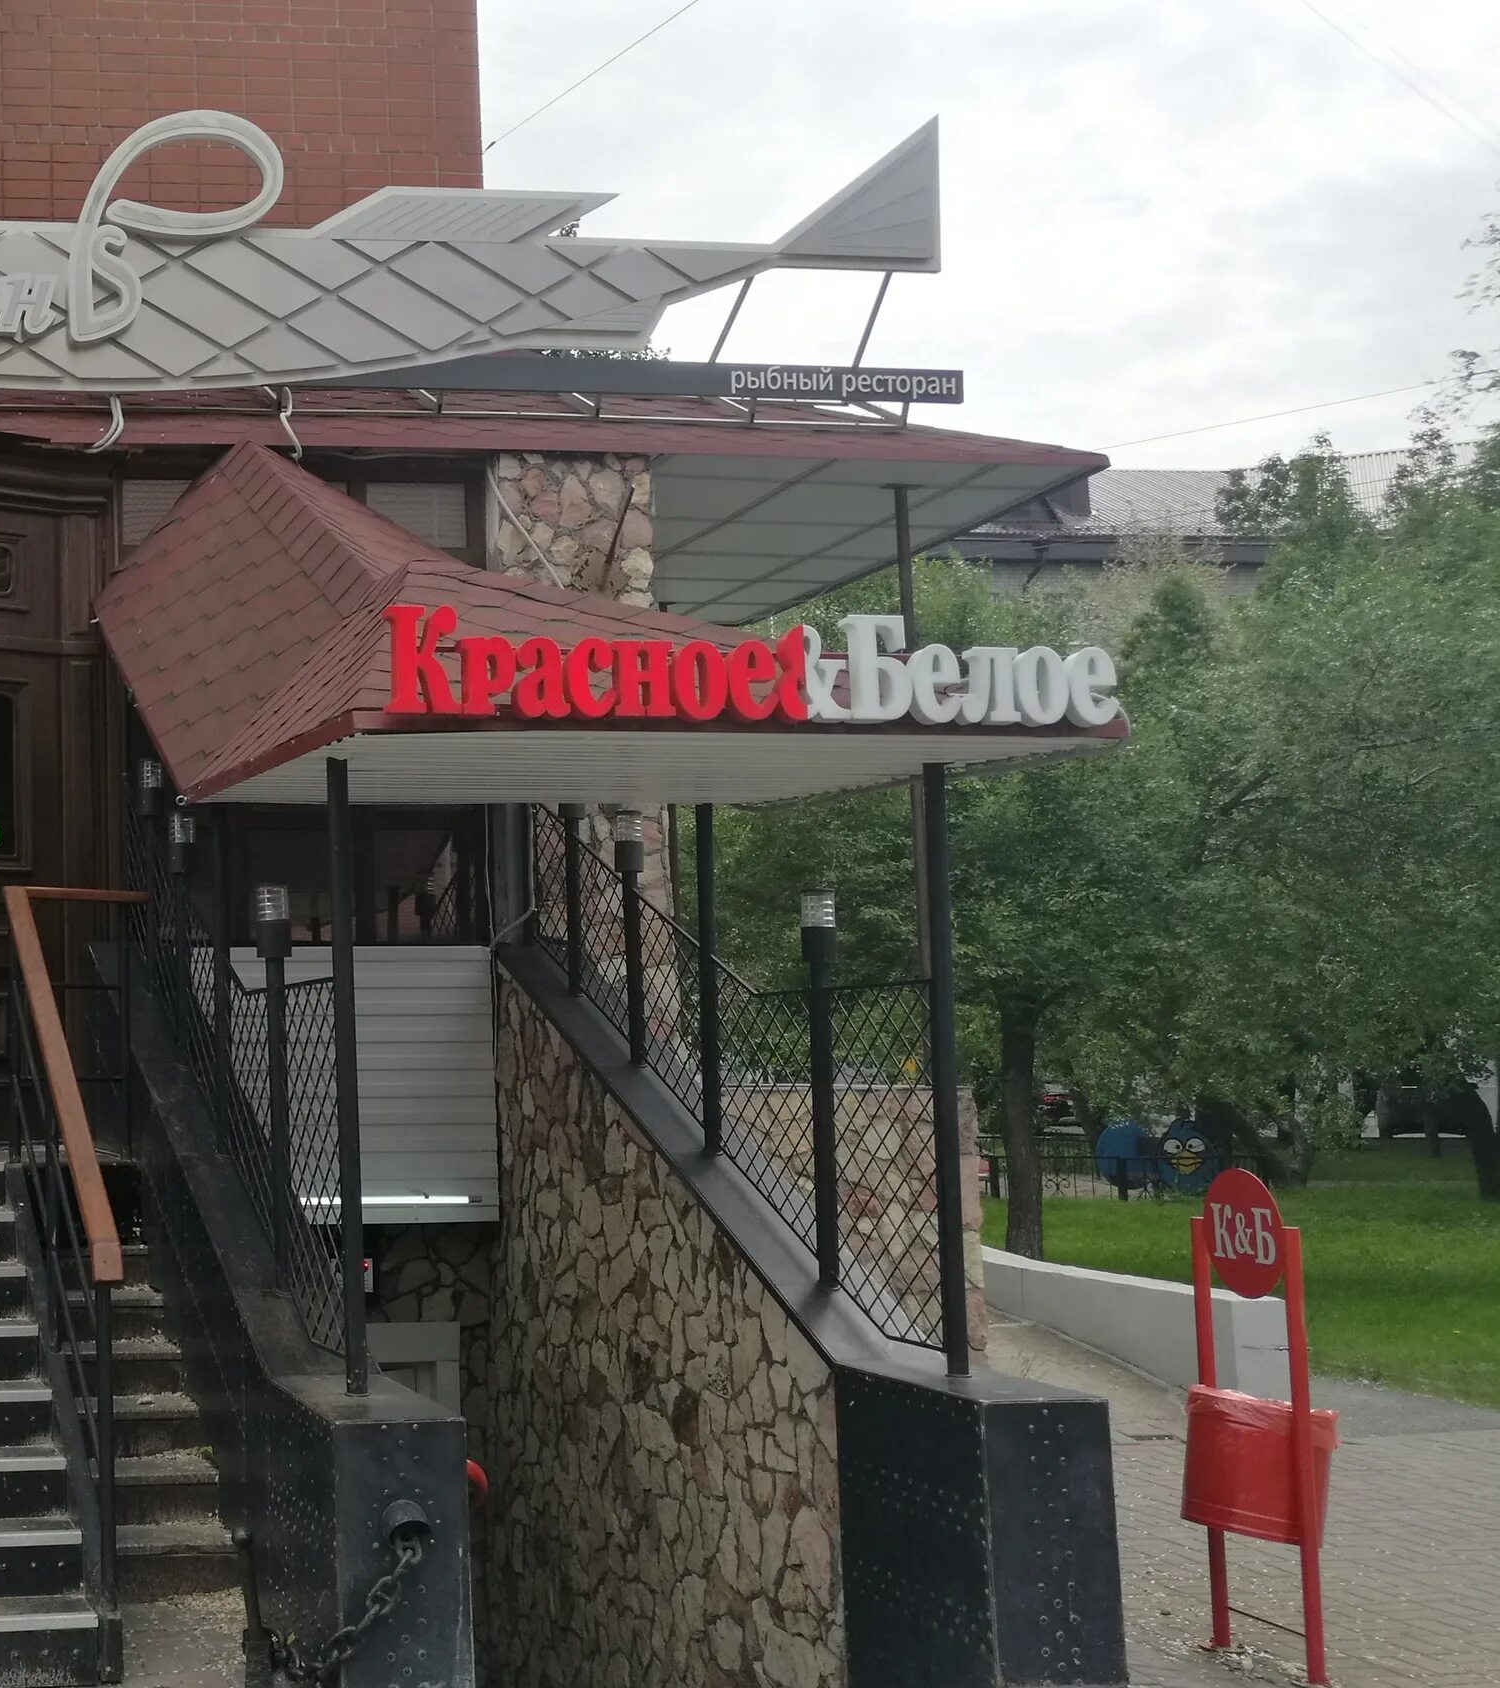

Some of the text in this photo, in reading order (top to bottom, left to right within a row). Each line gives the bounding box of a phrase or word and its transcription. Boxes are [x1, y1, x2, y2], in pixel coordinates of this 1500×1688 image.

[731, 366, 956, 399] рыбный ресторан
[1210, 1202, 1276, 1265] К&Б
